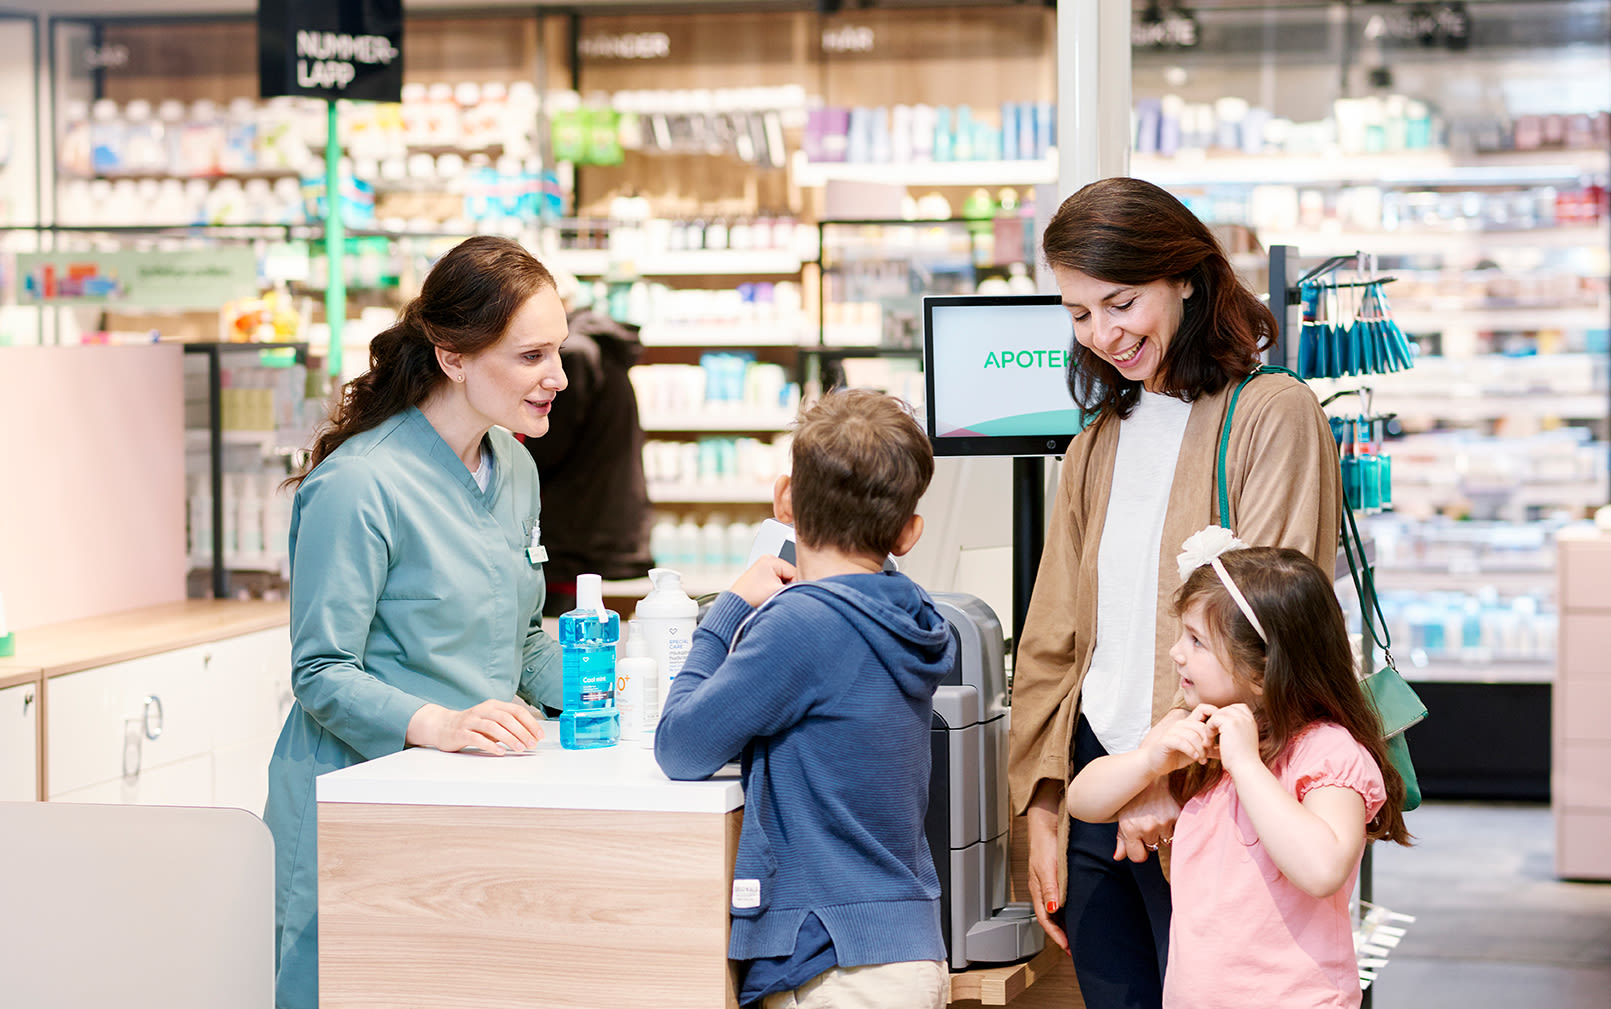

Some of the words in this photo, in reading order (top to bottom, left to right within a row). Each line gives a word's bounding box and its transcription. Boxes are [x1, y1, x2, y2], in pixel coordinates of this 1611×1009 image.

[297, 30, 399, 63] NUMMER-
[297, 59, 356, 88] LAPP
[984, 350, 1077, 368] APOTEK
[617, 674, 630, 691] 0+
